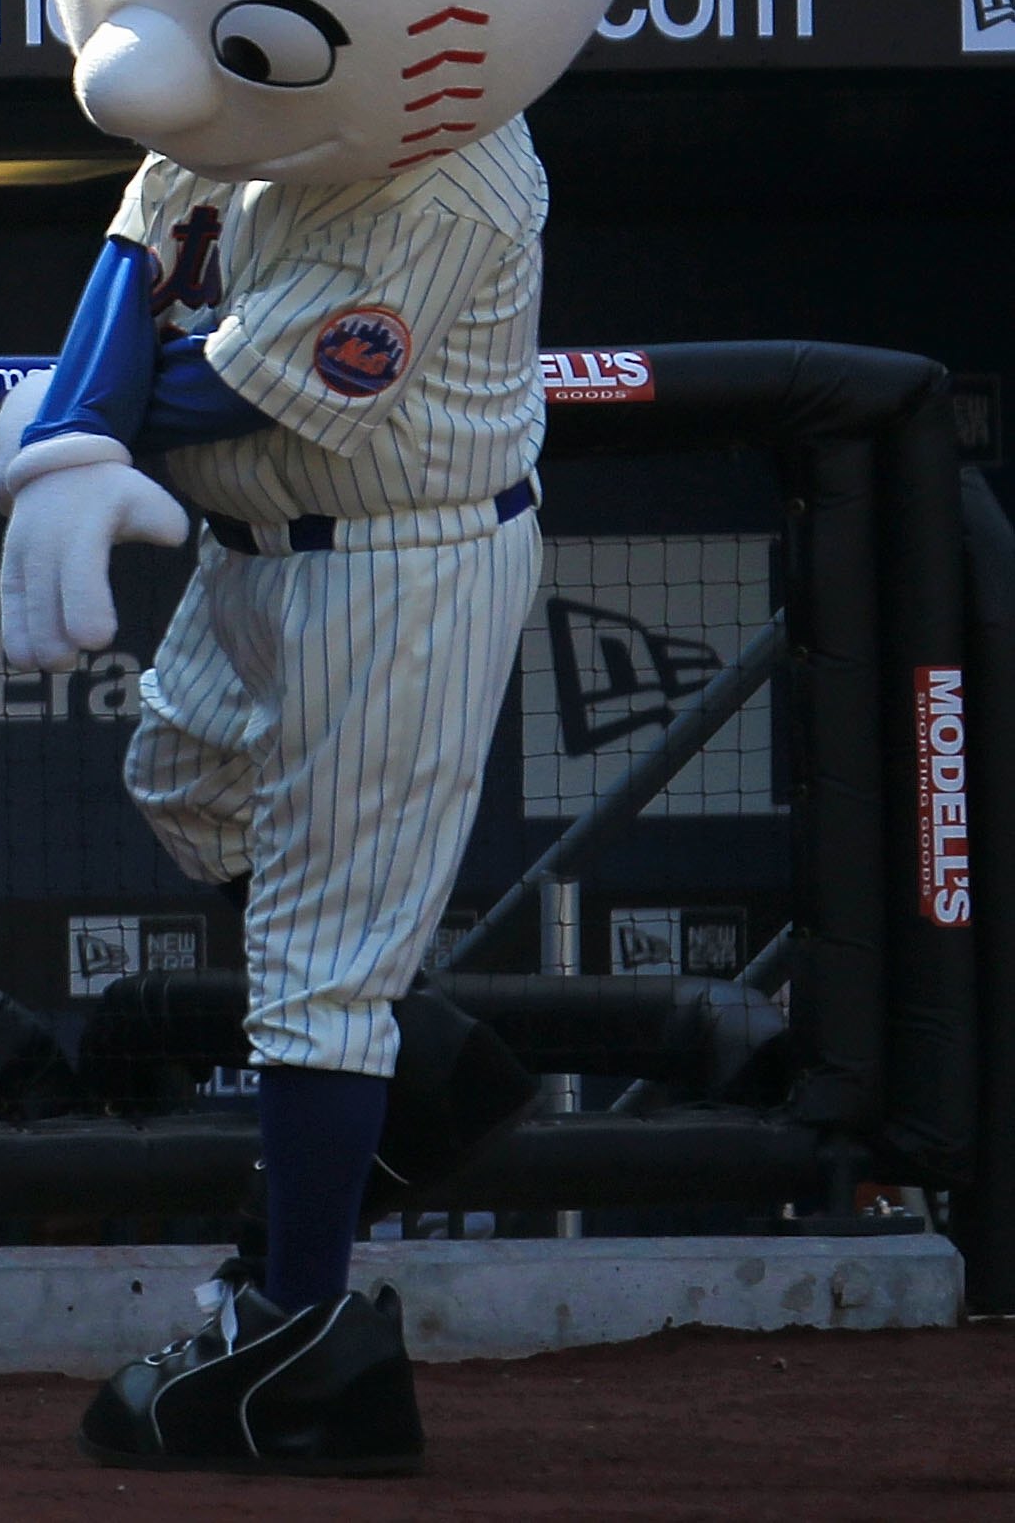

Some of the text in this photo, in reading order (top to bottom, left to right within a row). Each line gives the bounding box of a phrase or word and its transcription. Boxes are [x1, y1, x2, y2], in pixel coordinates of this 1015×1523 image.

[539, 351, 649, 387] ELL'S
[555, 390, 628, 399] GOODS
[916, 691, 932, 897] SPORTING GOODS
[929, 669, 972, 924] MODELL'S
